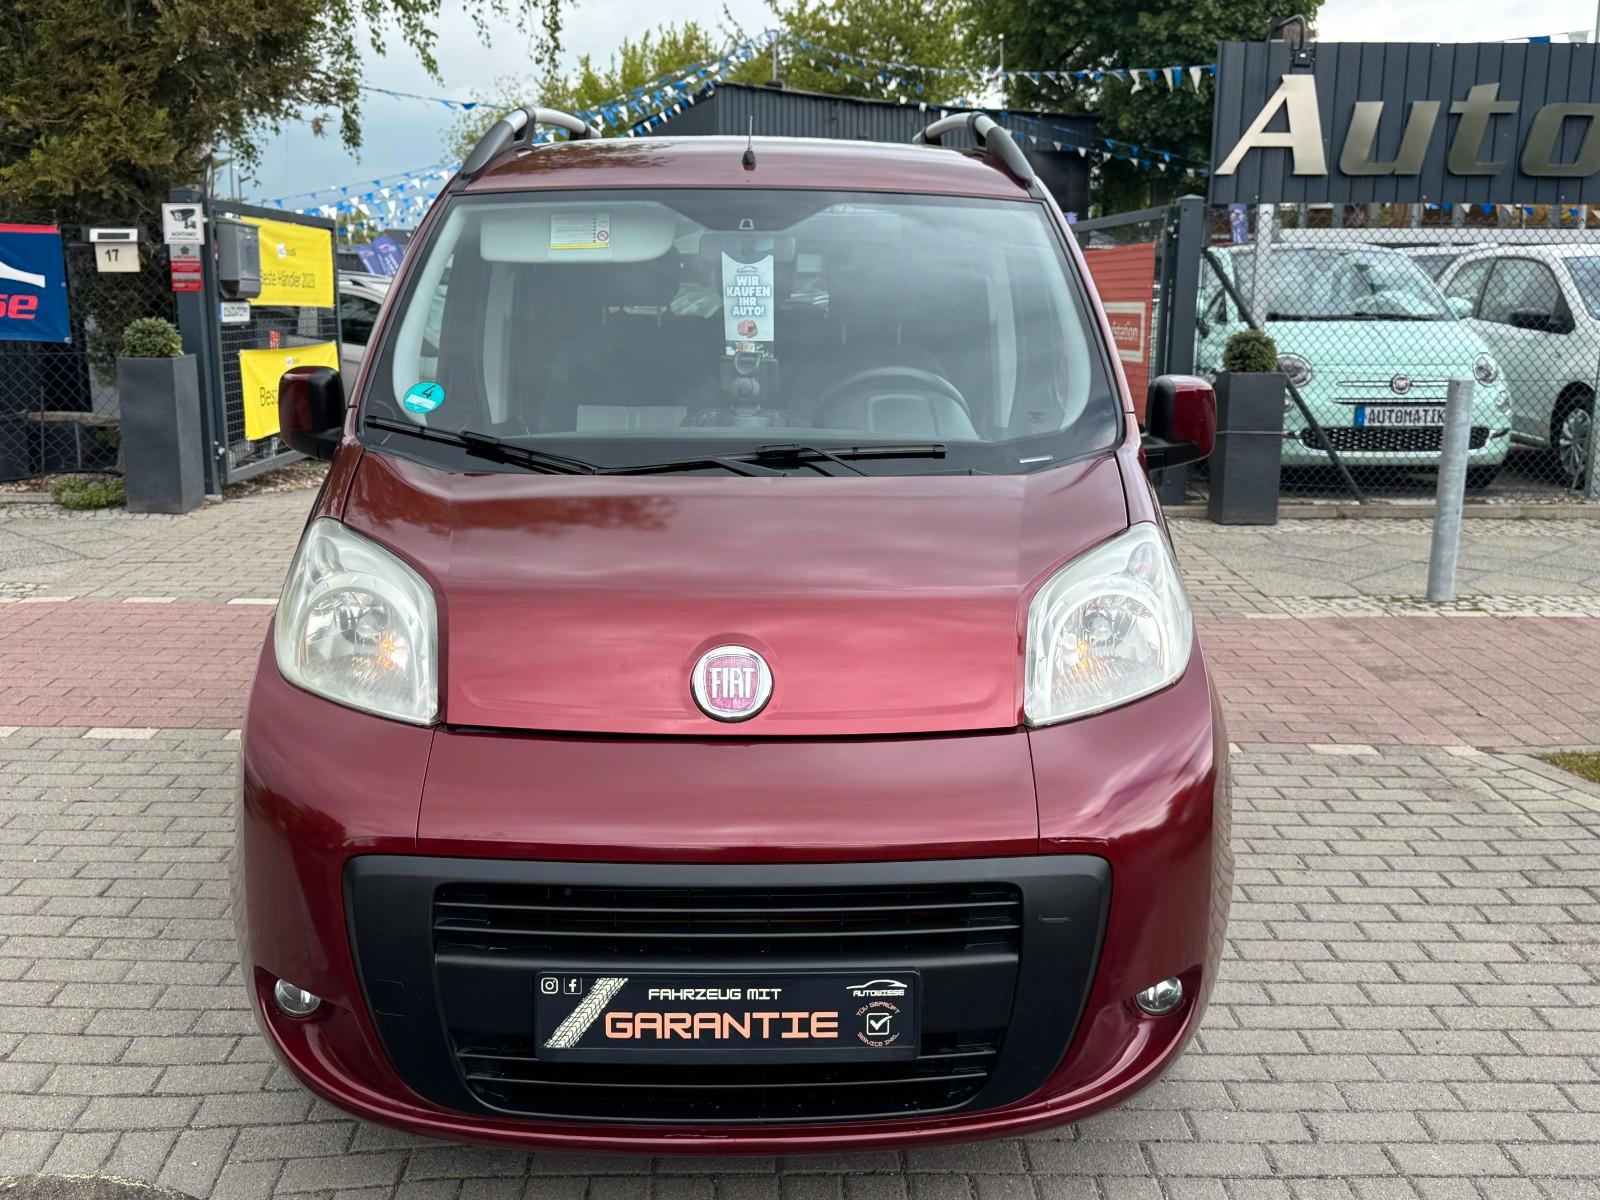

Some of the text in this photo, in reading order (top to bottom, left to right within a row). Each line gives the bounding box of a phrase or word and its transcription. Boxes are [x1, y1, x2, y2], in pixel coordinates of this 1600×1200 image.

[105, 248, 119, 262] 17
[259, 271, 277, 287] este
[736, 276, 759, 286] WIR
[726, 286, 771, 297] KAUFEN
[739, 297, 757, 307] IHR
[733, 307, 765, 317] AUTO!
[422, 384, 436, 398] 4
[1368, 408, 1446, 424] AUTOMATIK
[710, 667, 755, 699] FIAT
[648, 988, 782, 1001] FAHRZEUG MIT
[853, 989, 904, 997] AUTOWIESE
[605, 1011, 839, 1040] GARANTIE
